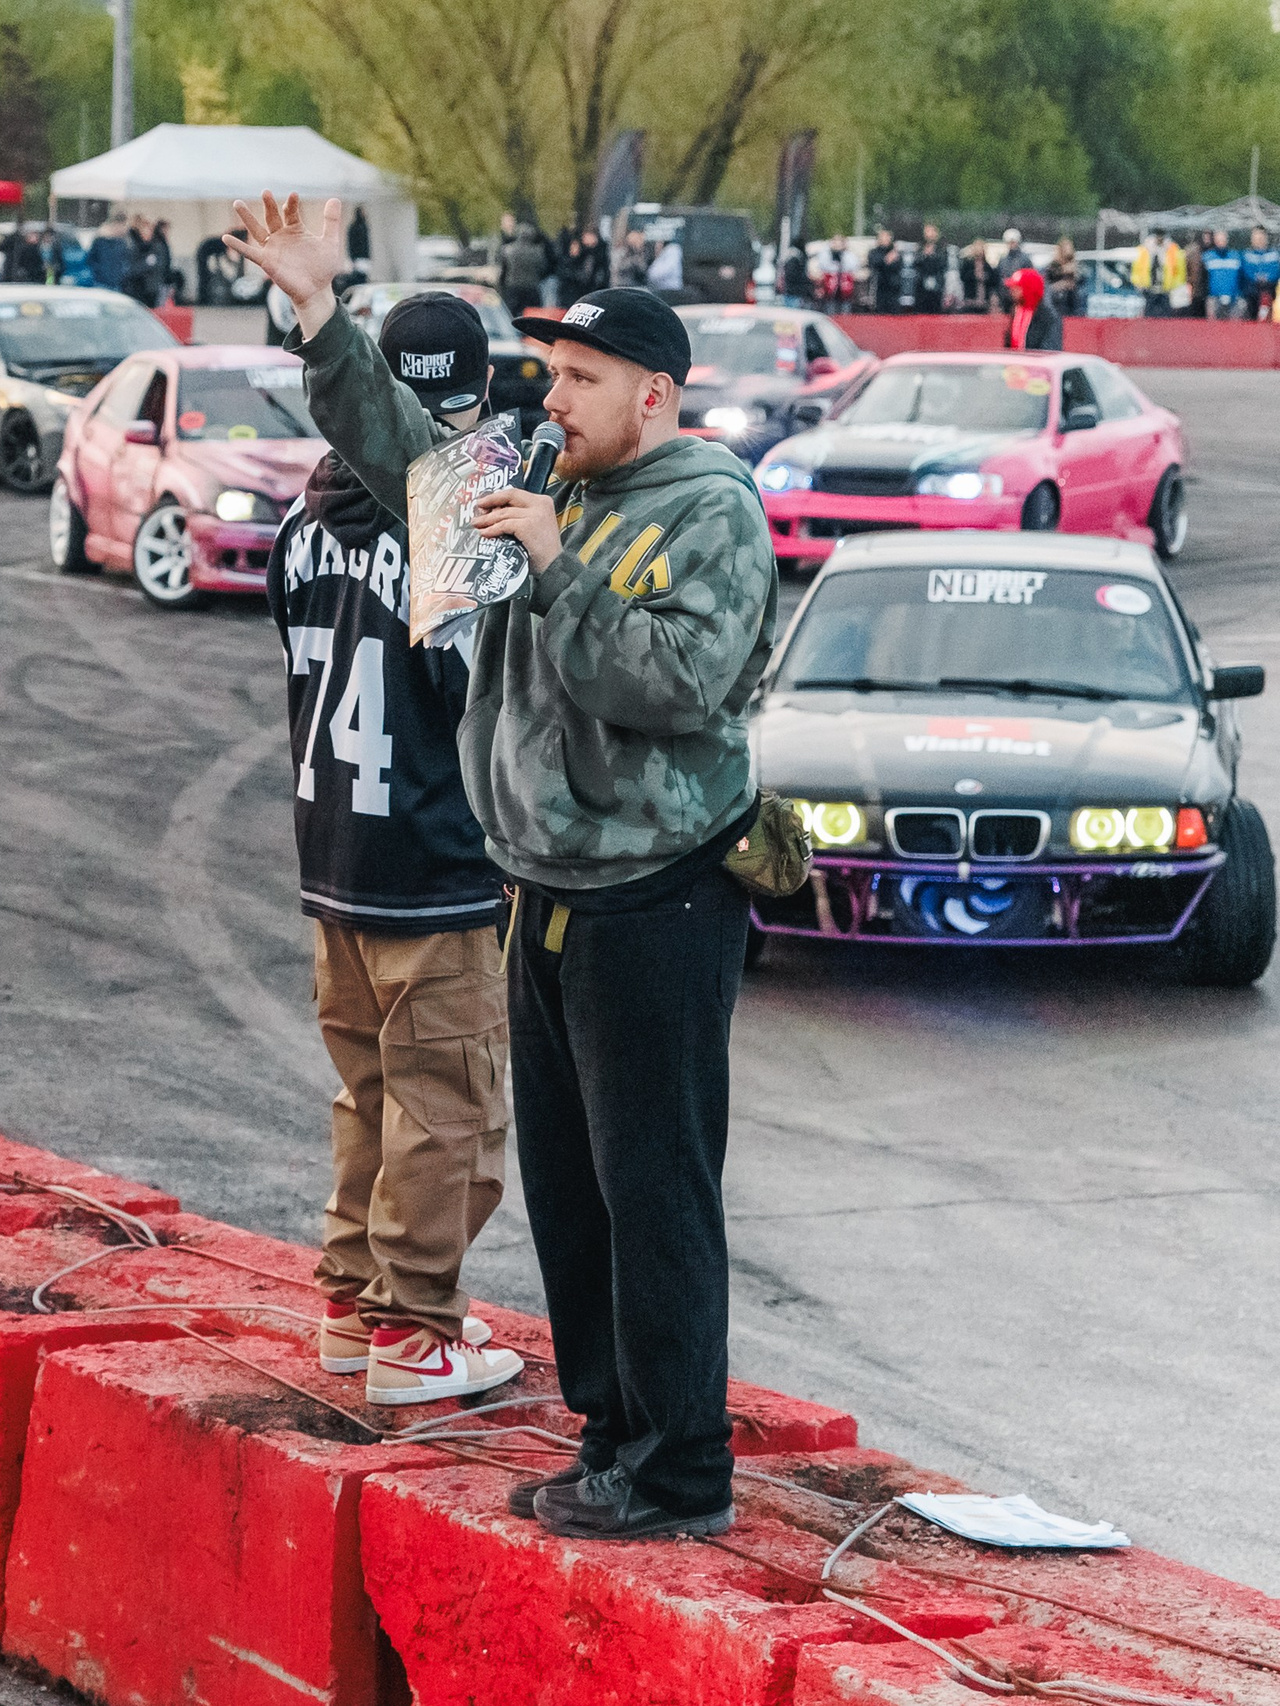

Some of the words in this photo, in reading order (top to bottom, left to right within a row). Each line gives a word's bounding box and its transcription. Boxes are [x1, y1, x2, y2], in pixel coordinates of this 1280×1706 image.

[424, 350, 456, 367] DRIFT
[424, 364, 452, 379] FEST
[286, 626, 393, 817] 74
